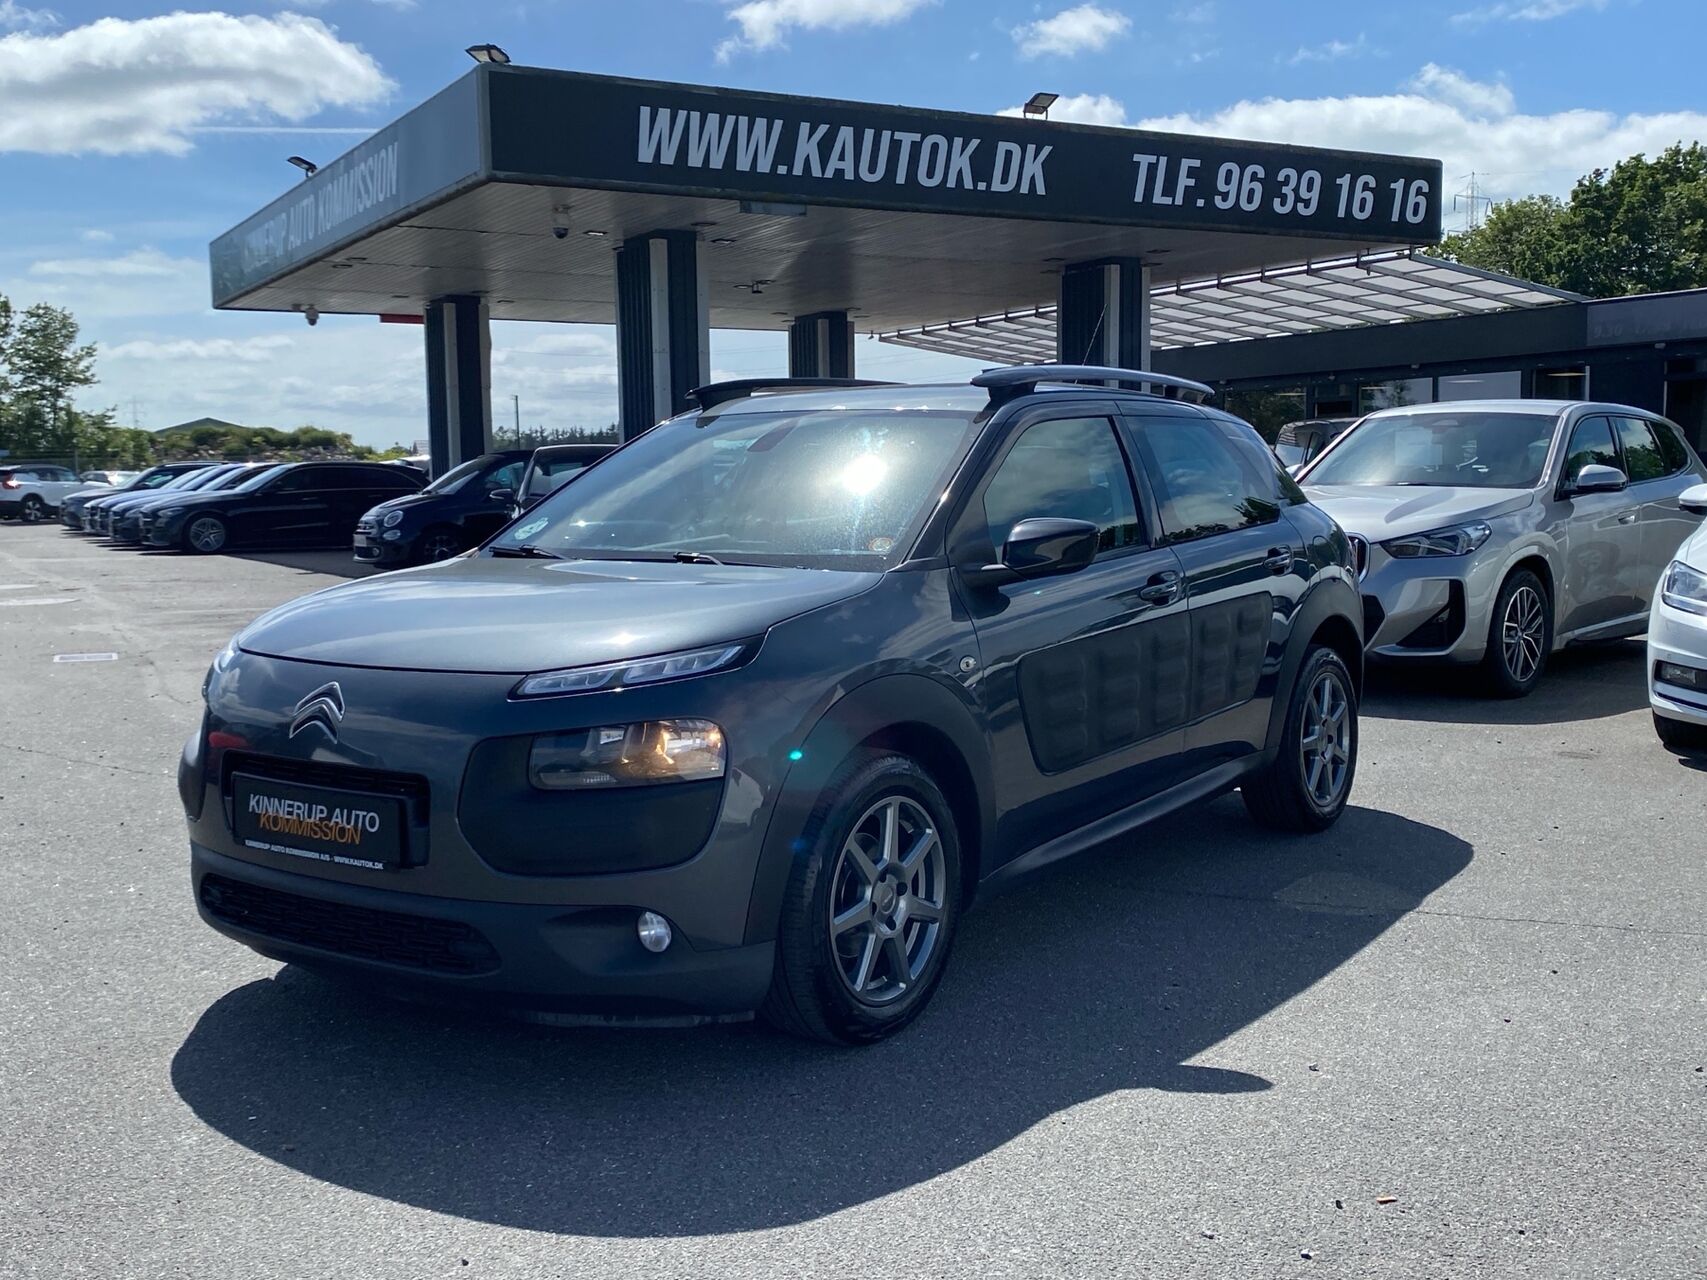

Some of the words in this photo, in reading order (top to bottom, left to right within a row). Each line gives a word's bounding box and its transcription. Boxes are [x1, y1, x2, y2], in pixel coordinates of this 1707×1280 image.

[638, 105, 1053, 196] WWW.KAUTOK.DK
[288, 194, 315, 250] AUTO
[318, 142, 398, 235] KOMMISSION
[1132, 153, 1205, 207] TLF.
[1214, 162, 1265, 212] 96
[1273, 167, 1322, 216] 39
[1335, 173, 1376, 220] 16
[1390, 178, 1429, 224] 16
[249, 794, 327, 821] KINNERUP
[329, 808, 380, 832] AUTO
[260, 812, 360, 844] KOMMISSION
